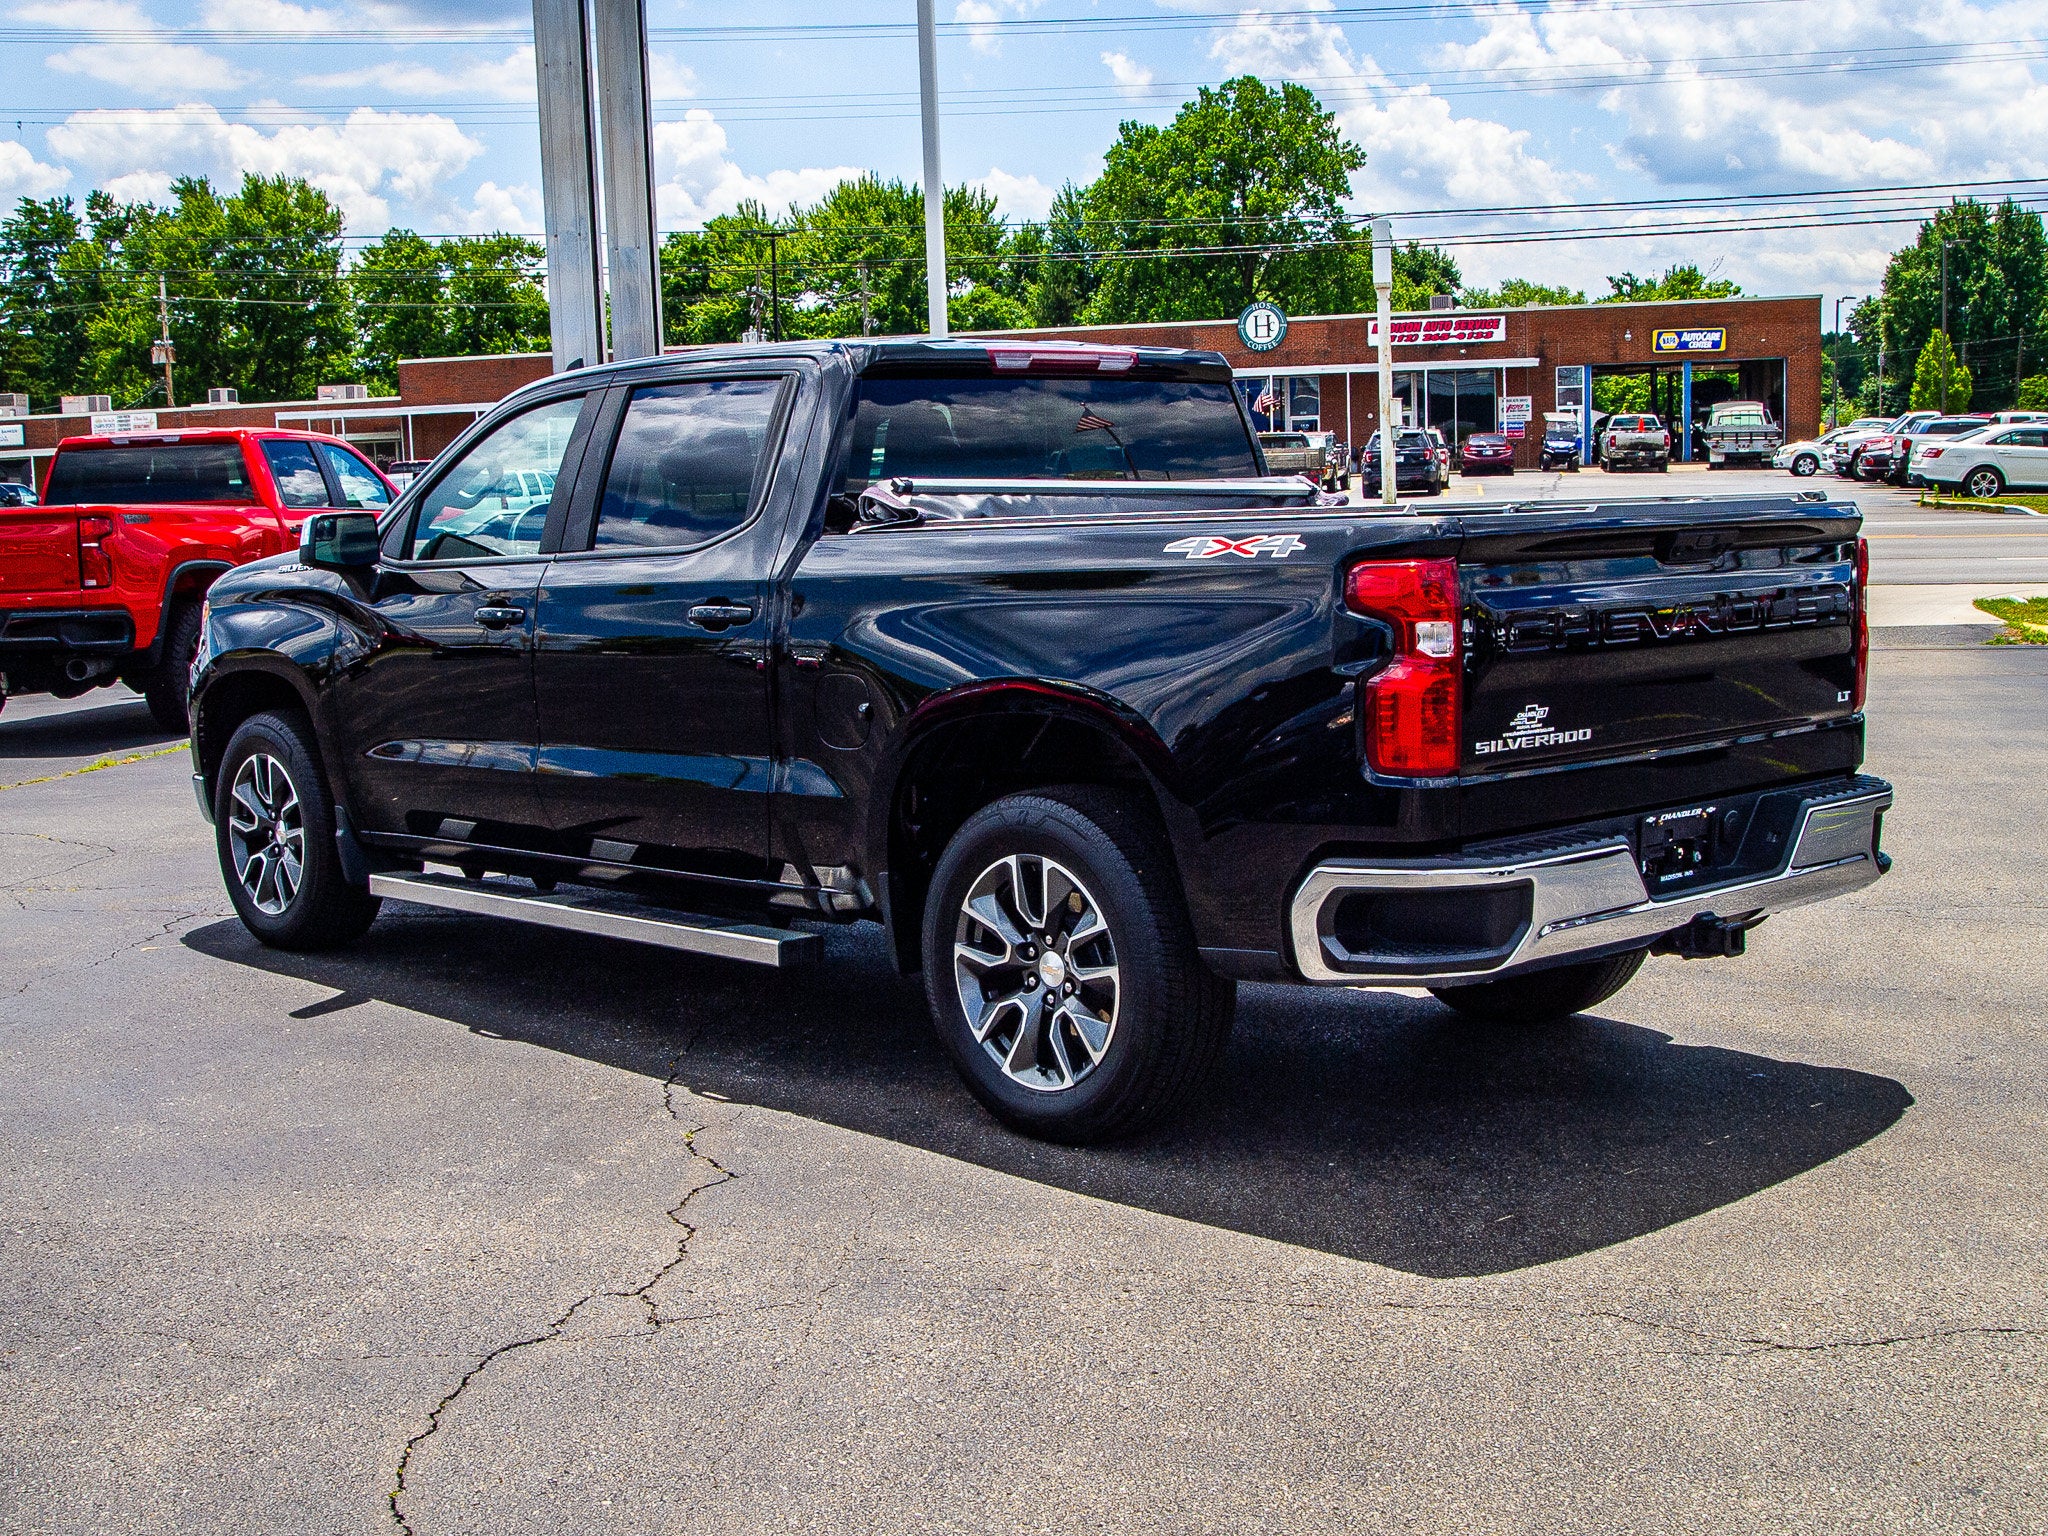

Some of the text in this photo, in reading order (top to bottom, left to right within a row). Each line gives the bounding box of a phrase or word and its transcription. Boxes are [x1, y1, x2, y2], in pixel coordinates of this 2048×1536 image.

[1251, 302, 1272, 310] HOS
[1423, 320, 1453, 332] AUTO
[1454, 318, 1501, 331] SERVICE
[1247, 340, 1278, 351] COFFEE
[1505, 586, 1847, 652] CHEVROLET
[1837, 690, 1851, 702] LT
[1475, 728, 1592, 755] SILVERADO
[1660, 808, 1702, 820] CHANDLER
